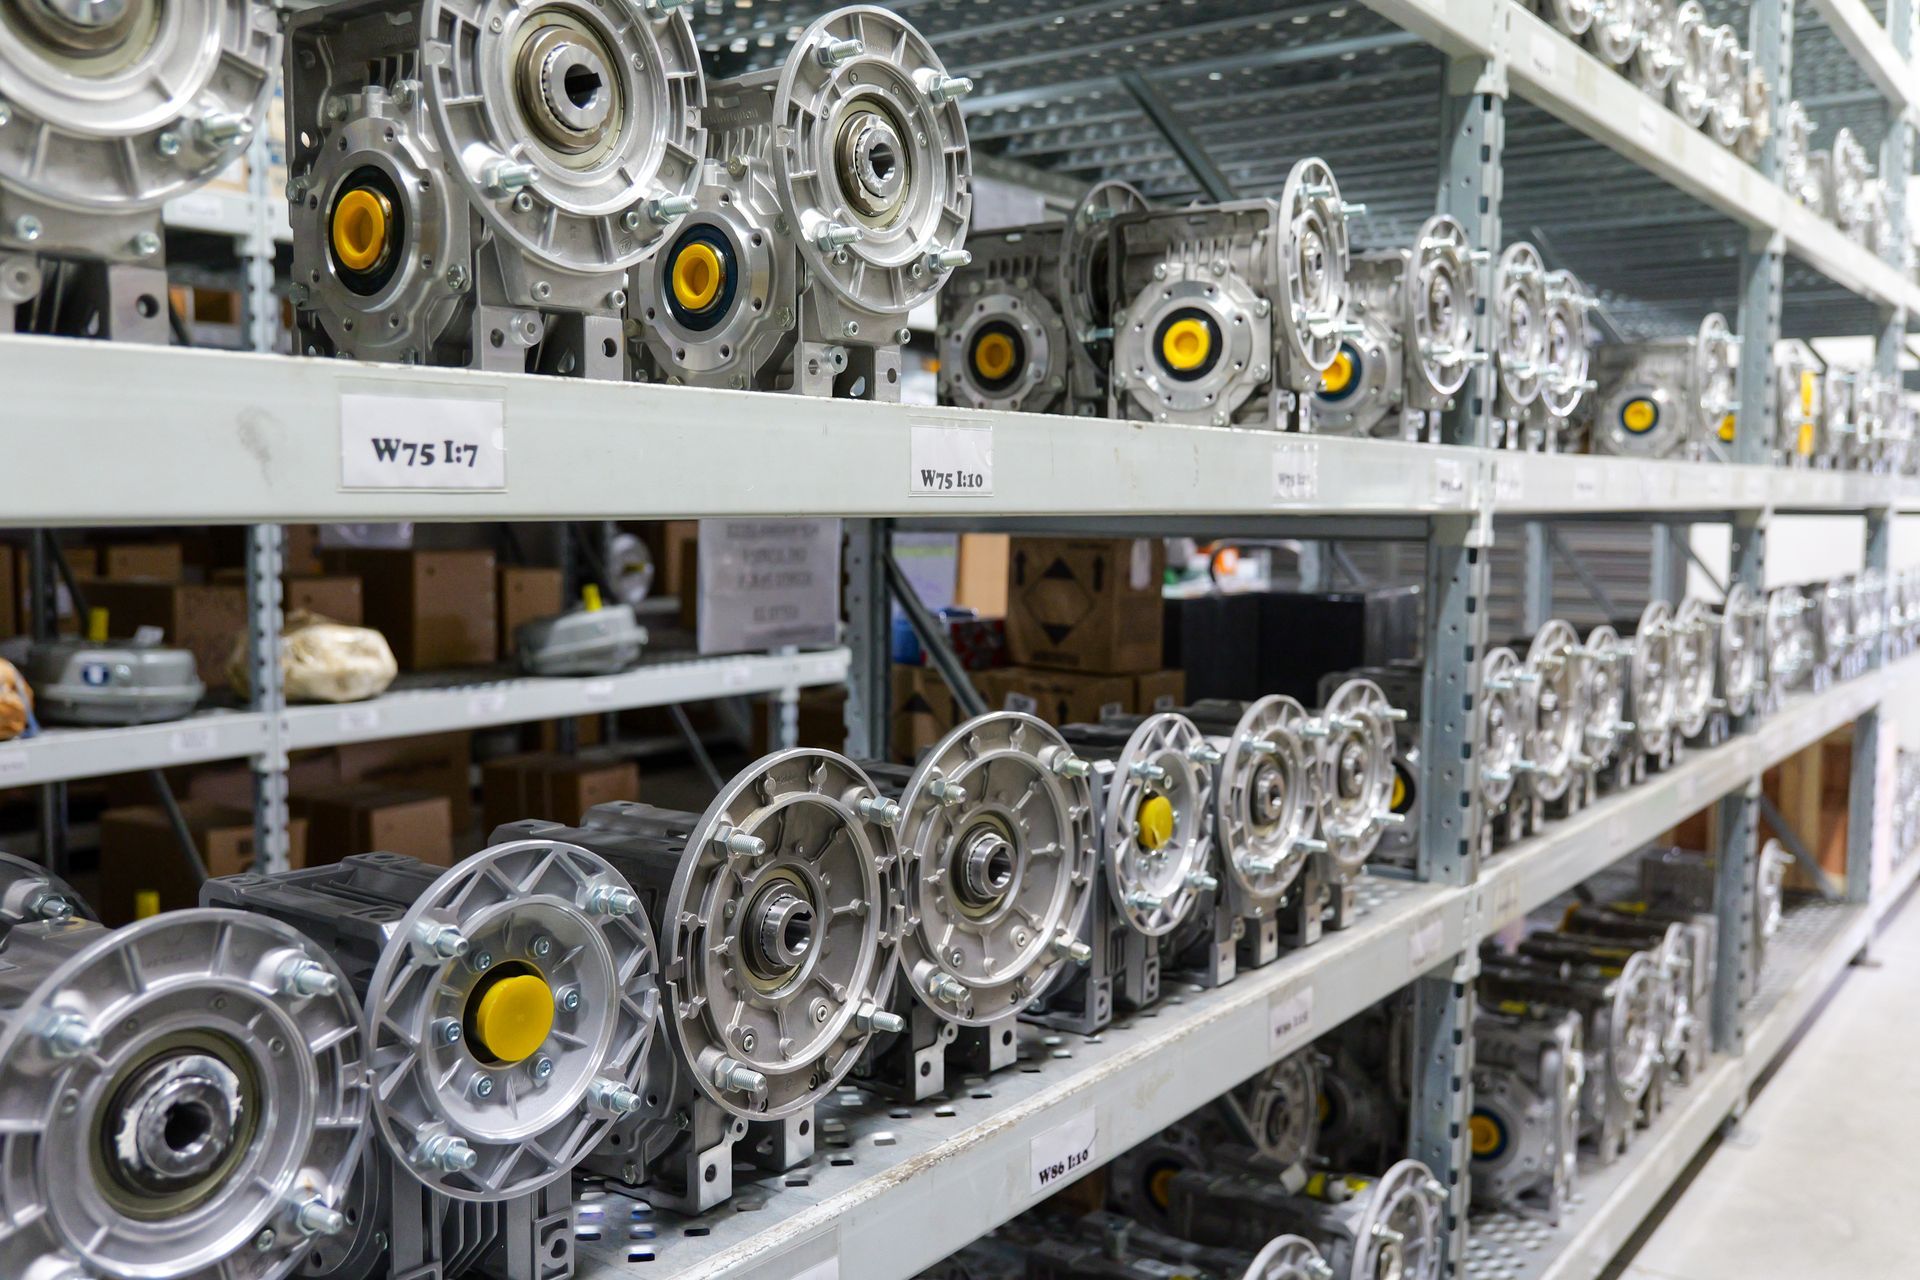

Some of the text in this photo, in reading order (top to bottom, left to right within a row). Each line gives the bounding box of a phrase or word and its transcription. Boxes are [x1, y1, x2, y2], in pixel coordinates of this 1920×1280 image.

[371, 438, 479, 467] W75 I:7
[920, 469, 983, 490] W75 I:10
[1038, 1149, 1089, 1185] W86 I:10
